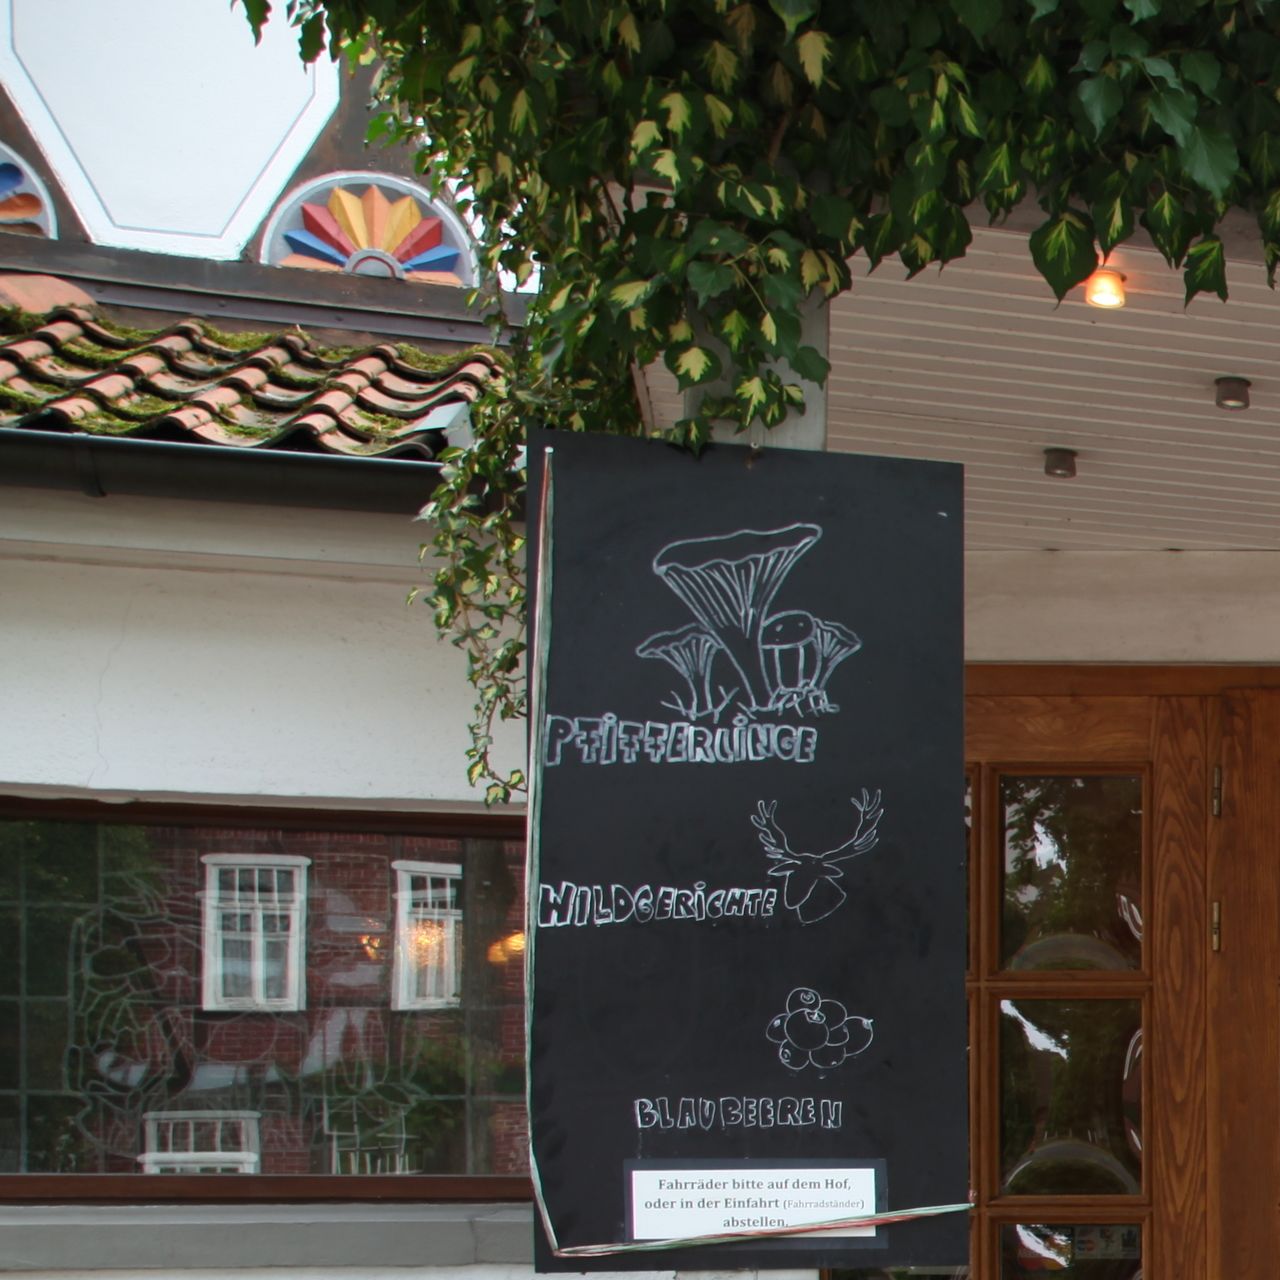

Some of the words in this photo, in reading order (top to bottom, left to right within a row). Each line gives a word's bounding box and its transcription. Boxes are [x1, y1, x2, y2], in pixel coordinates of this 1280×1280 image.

[634, 1097, 843, 1131] BLAUBEEREN
[658, 1178, 728, 1190] Fahrräder
[732, 1178, 764, 1190] bitte
[767, 1178, 789, 1190] auf
[792, 1178, 820, 1190] dem
[825, 1178, 852, 1192] Hof,
[644, 1198, 678, 1210] oder
[680, 1198, 693, 1209] in
[697, 1198, 720, 1209] der
[724, 1198, 779, 1209] Einfahrt
